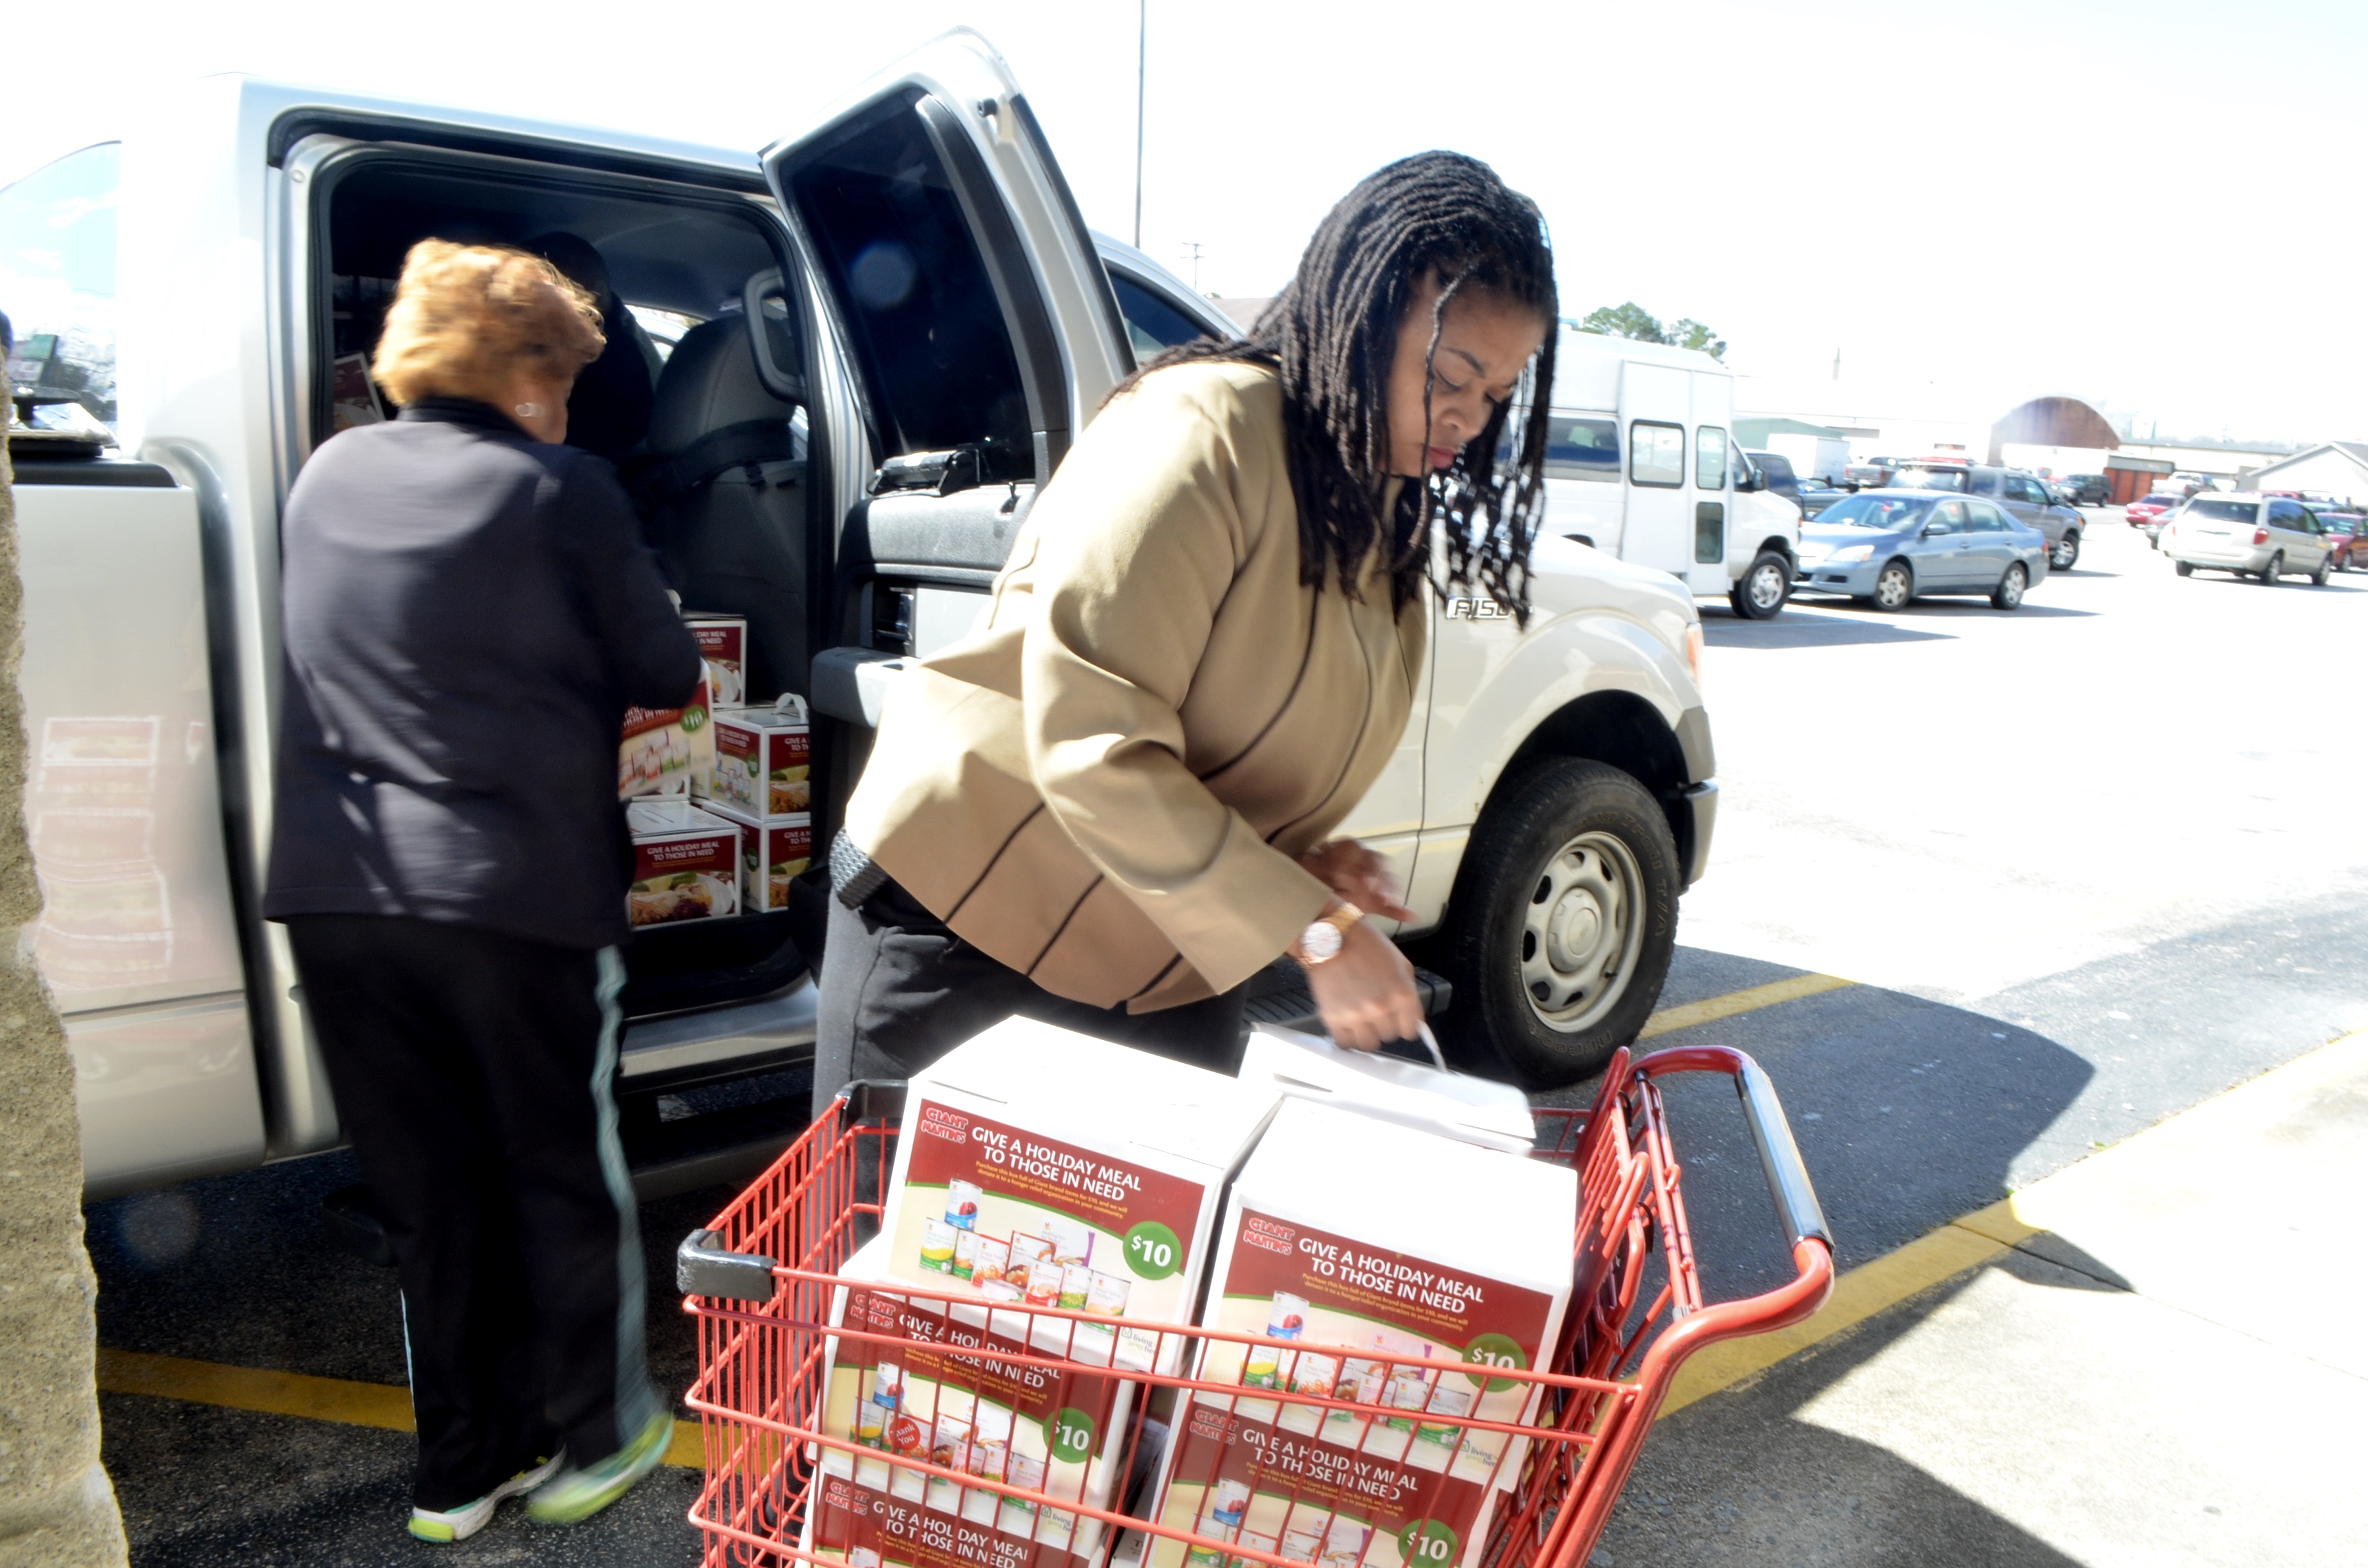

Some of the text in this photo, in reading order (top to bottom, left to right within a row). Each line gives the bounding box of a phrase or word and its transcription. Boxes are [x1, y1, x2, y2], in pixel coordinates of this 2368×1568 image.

[646, 847, 663, 855] GIVE
[671, 843, 700, 852] HOLIDAY
[665, 851, 687, 860] THOSE
[696, 848, 714, 856] NEED
[926, 1107, 968, 1130] GIANT
[973, 1127, 1142, 1191] GIVE A HOLIDAY MEAL
[984, 1145, 1125, 1201] TO THOSE IN NEED
[1249, 1218, 1295, 1241] GIANT
[1131, 1235, 1171, 1267] $10
[1299, 1237, 1484, 1303] GIVE A HOLIDAY MEAL
[1311, 1257, 1466, 1314] TO THOSE IN NEED
[855, 1294, 896, 1316] GANT
[1133, 1334, 1153, 1347] living
[985, 1359, 1002, 1375] IN
[898, 1435, 914, 1444] You
[1282, 1442, 1294, 1455] A
[1254, 1447, 1276, 1464] TO
[1471, 1447, 1492, 1460] living
[873, 1501, 907, 1521] GVE
[909, 1513, 919, 1526] A
[923, 1517, 989, 1548] HOLDAY
[1053, 1513, 1071, 1527] living
[886, 1519, 904, 1534] TO
[957, 1543, 974, 1558] IN
[1406, 1531, 1448, 1560] $10
